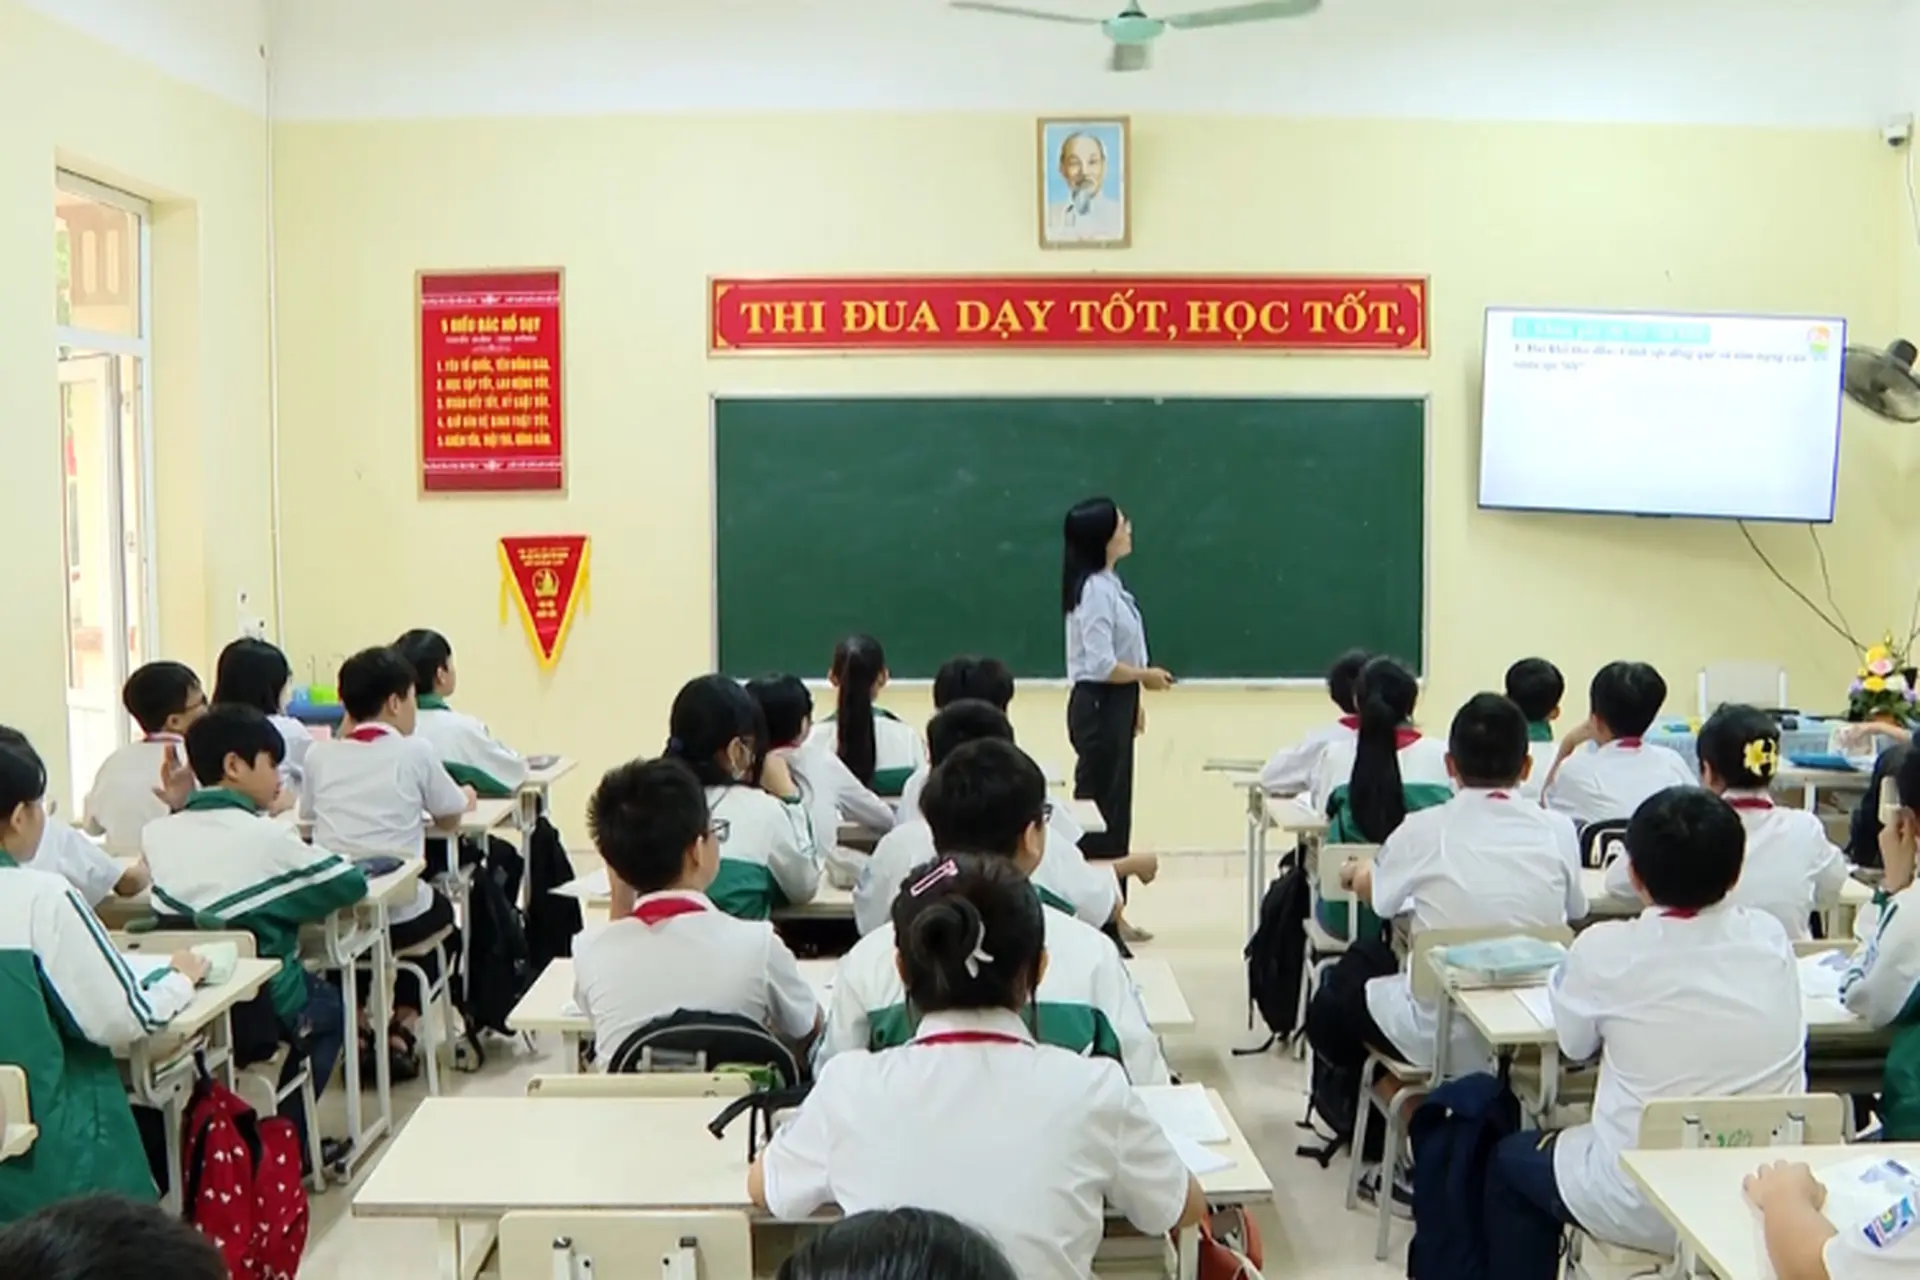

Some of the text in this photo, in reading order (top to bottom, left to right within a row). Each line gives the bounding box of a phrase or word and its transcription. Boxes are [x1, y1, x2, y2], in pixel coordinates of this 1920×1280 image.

[740, 288, 1406, 340] THI ĐUA DẠY TỐT, HỌC TỐT.
